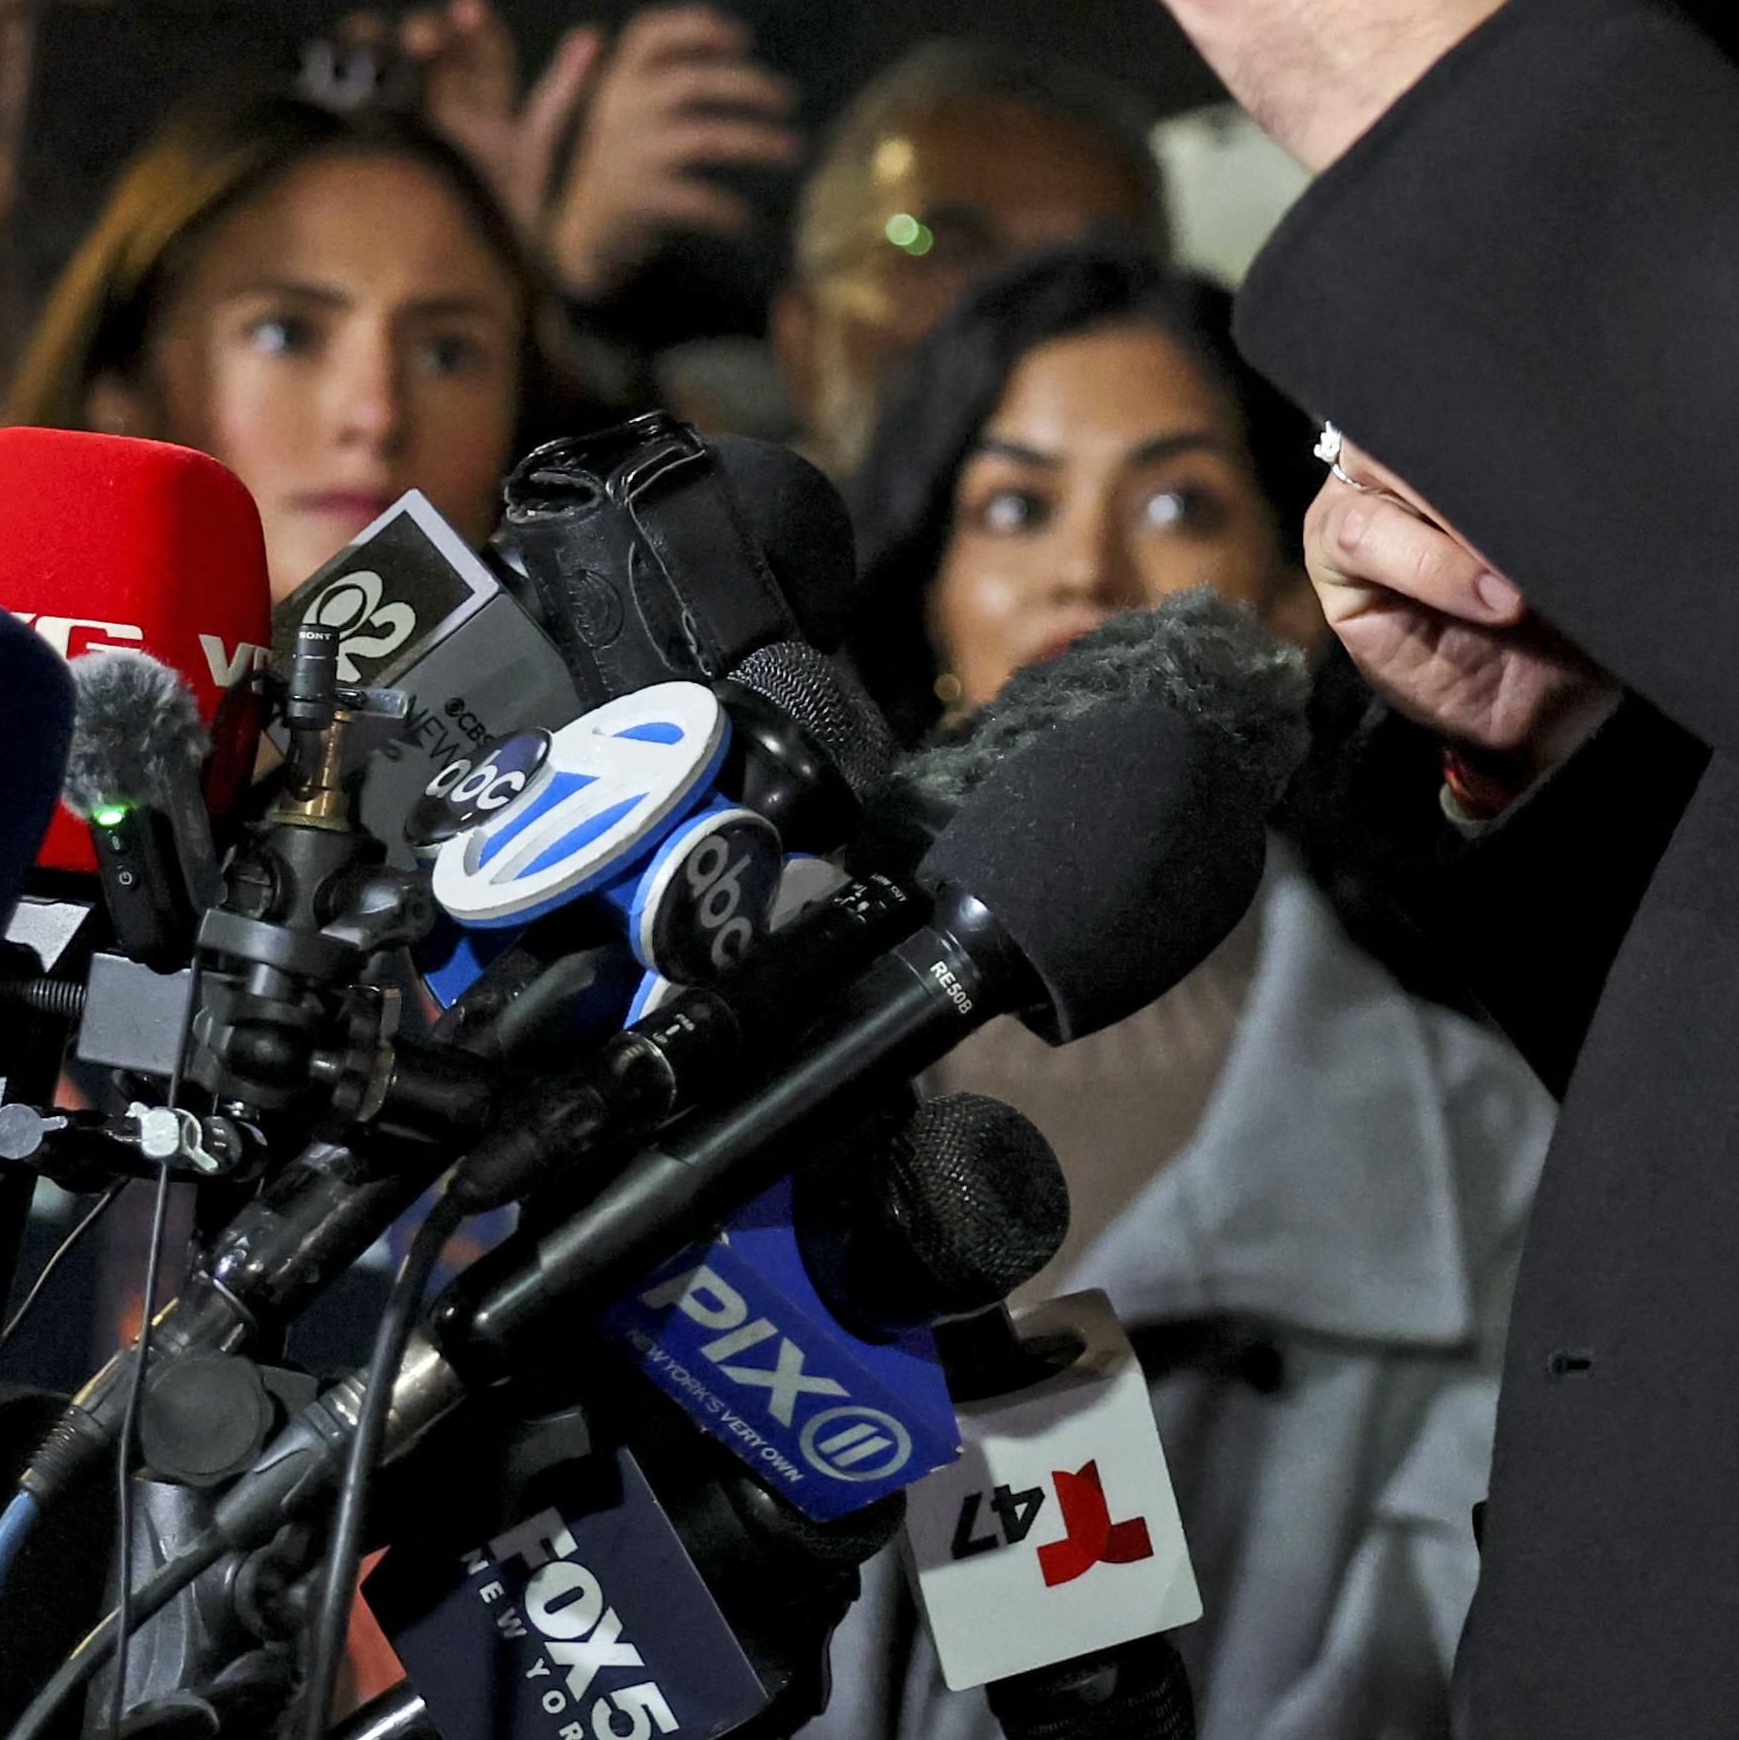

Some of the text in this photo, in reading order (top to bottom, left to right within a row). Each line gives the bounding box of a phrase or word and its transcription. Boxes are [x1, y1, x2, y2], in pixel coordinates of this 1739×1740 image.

[424, 748, 526, 810] abc
[685, 834, 754, 968] abc
[929, 960, 973, 1015] RE50B
[637, 1264, 852, 1429] PIX
[719, 1409, 768, 1450] VERY
[759, 1445, 805, 1484] OWN
[951, 1483, 1046, 1560] 47
[459, 1546, 528, 1640] NEW
